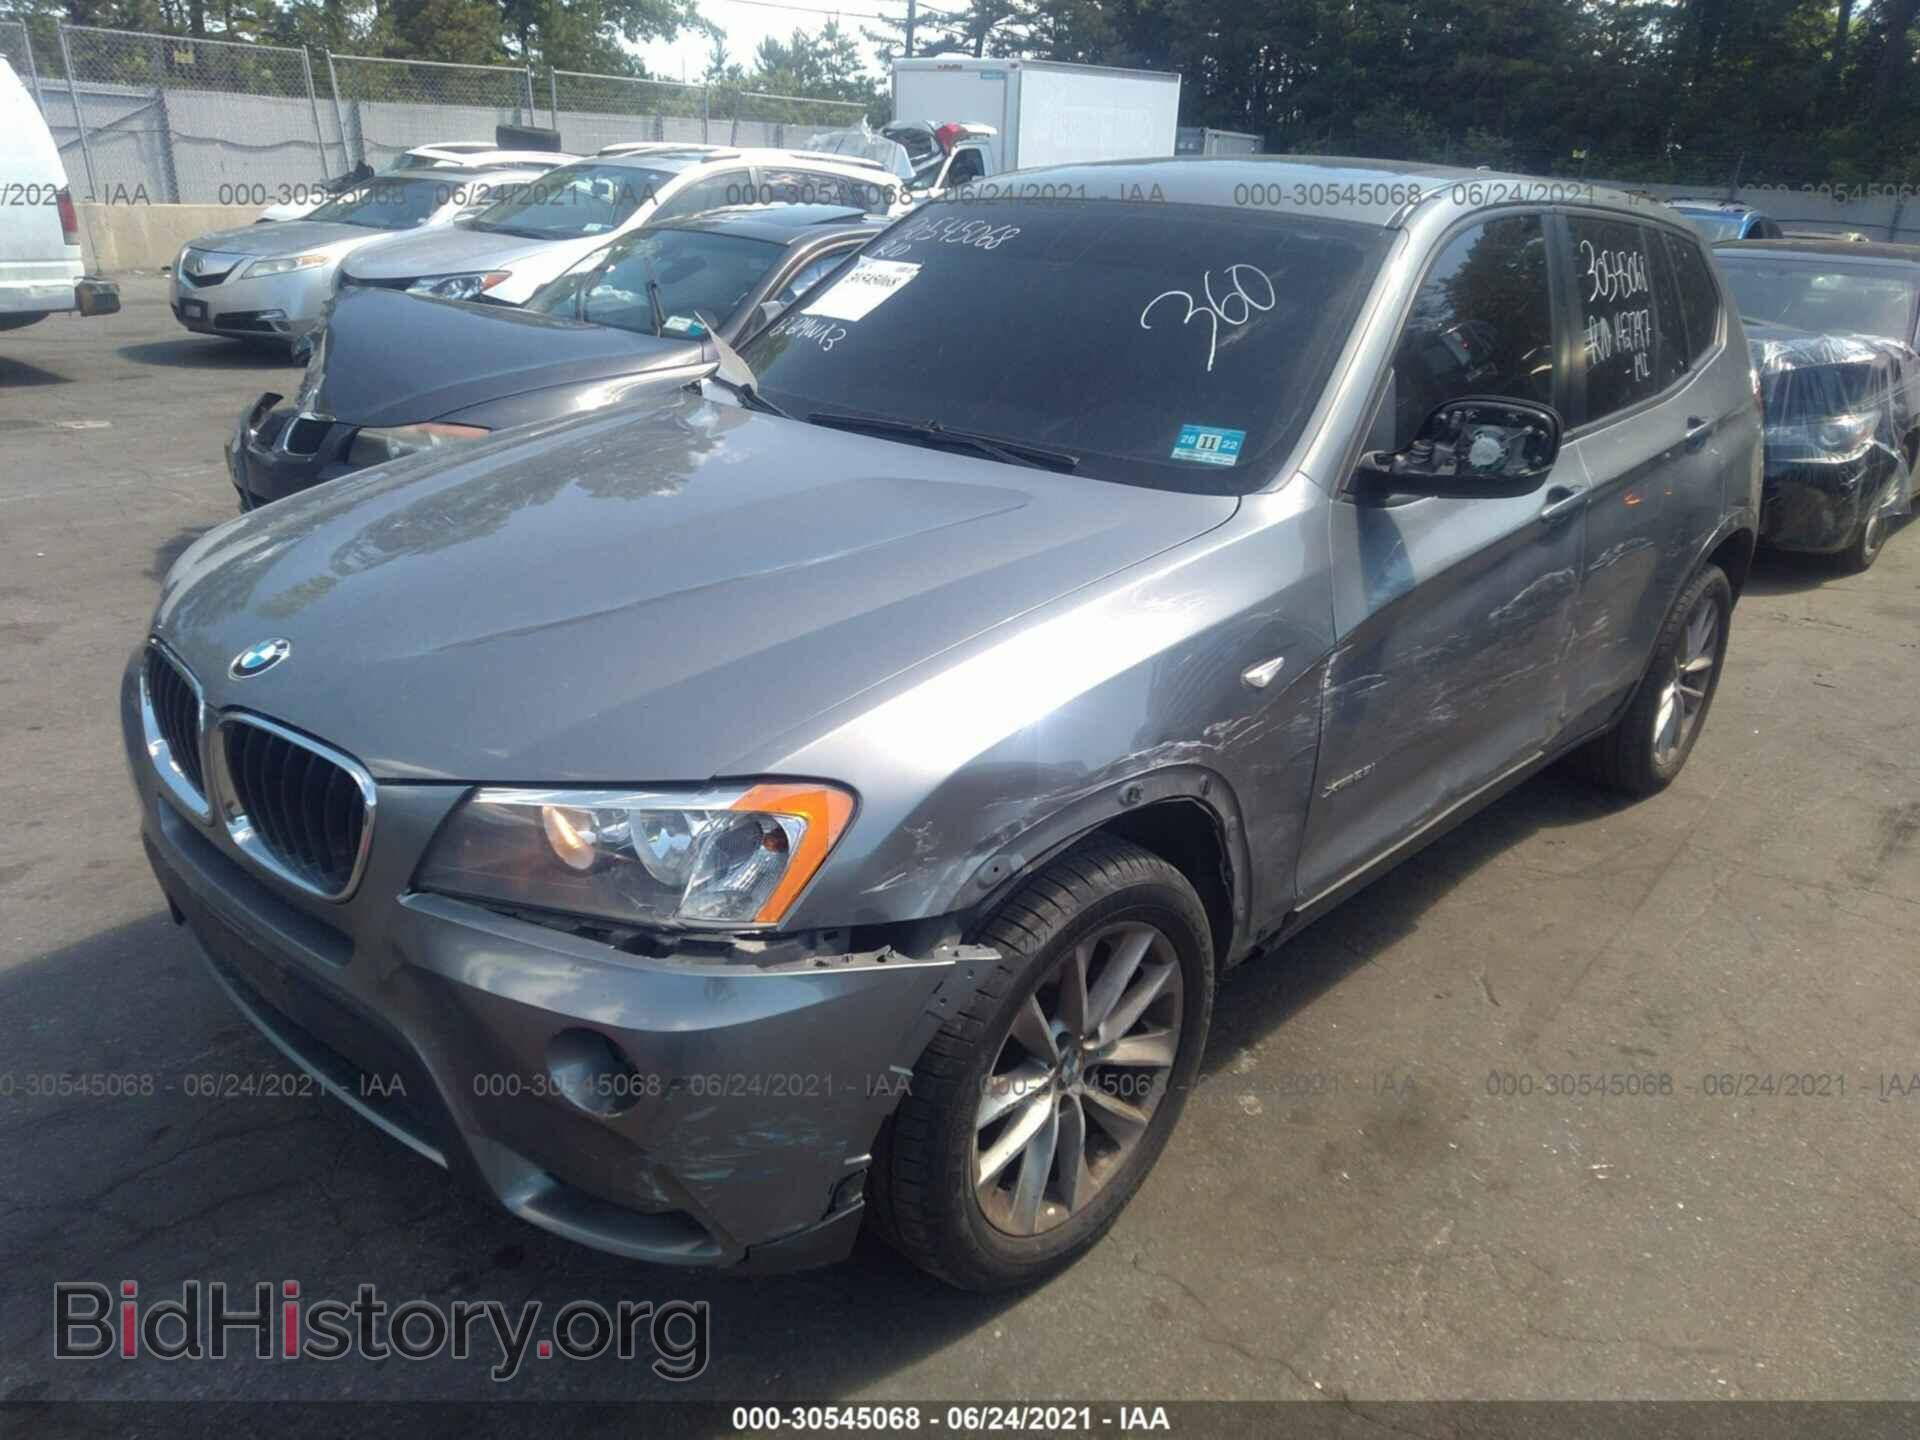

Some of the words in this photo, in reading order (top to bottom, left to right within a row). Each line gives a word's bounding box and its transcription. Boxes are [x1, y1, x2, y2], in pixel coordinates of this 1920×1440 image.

[1140, 263, 1276, 372] 360
[1179, 433, 1197, 445] 20
[1199, 435, 1219, 450] 11
[1220, 439, 1239, 451] 22
